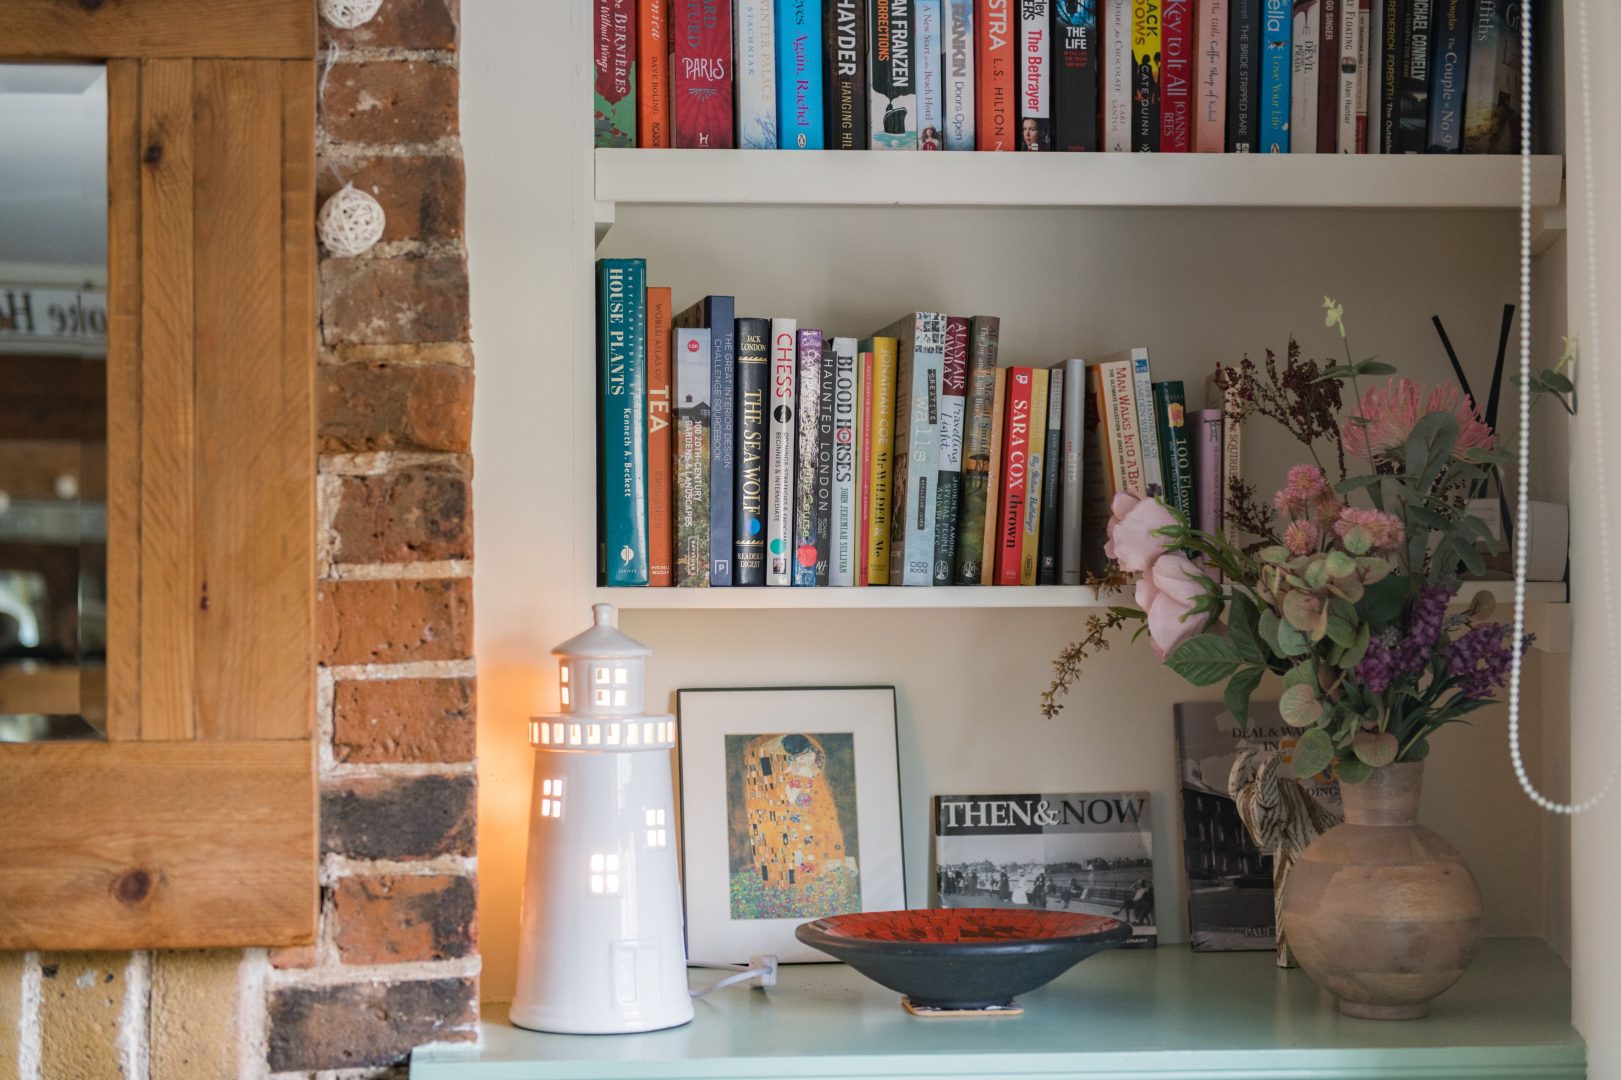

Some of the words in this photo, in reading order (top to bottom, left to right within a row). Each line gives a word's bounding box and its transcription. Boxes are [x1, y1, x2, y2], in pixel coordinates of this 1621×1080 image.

[600, 6, 612, 42] Without
[923, 14, 932, 33] New
[1146, 0, 1158, 38] ACK
[1162, 0, 1187, 33] Key
[1210, 2, 1220, 14] The
[951, 4, 967, 78] RANKIN
[1028, 30, 1043, 53] The
[1065, 26, 1086, 38] THE
[1210, 17, 1220, 37] Little
[1240, 23, 1250, 41] THE
[1324, 13, 1335, 41] SINGER
[1344, 11, 1356, 51] FLOATING
[596, 44, 610, 73] Wings
[891, 20, 909, 87] FRANZEN
[923, 35, 932, 54] Start
[1065, 38, 1087, 50] LIFE
[1167, 36, 1183, 57] to
[1206, 40, 1219, 64] Coffee
[1239, 43, 1250, 69] BRIDE
[1294, 44, 1303, 73] PRADA
[1303, 41, 1314, 74] DEVIL
[1410, 34, 1428, 81] CONNELLY
[1446, 37, 1456, 51] The
[651, 56, 660, 79] DAVE
[681, 57, 725, 81] PARIS
[993, 58, 1004, 81] L.S.
[1141, 65, 1150, 98] CATE
[1167, 60, 1187, 71] It
[1204, 66, 1218, 87] Shop
[1272, 55, 1282, 81] Love
[1385, 54, 1396, 100] FORSYTH
[1440, 51, 1458, 100] Couple
[650, 82, 660, 115] BOLING
[923, 71, 933, 95] Beach
[953, 81, 965, 111] Doors
[1025, 56, 1043, 113] Betrayer
[1167, 73, 1188, 96] All
[1239, 71, 1250, 111] STRIPPED
[1271, 84, 1282, 107] Your
[1344, 80, 1354, 98] Alan
[795, 79, 810, 126] Rachel
[841, 81, 853, 129] HANGING
[924, 97, 935, 121] Hotel
[993, 87, 1005, 137] HILTON
[1111, 100, 1119, 132] SANTOS
[1141, 99, 1150, 136] QUINN
[1343, 99, 1353, 125] Hunter
[1385, 102, 1393, 118] The
[952, 114, 965, 141] Open
[1163, 112, 1175, 136] REES
[1174, 100, 1186, 147] JOANNA
[1238, 113, 1249, 136] BARE
[1440, 109, 1455, 144] No.9
[609, 268, 625, 324] HOUSE
[654, 303, 664, 337] WORLD
[980, 326, 989, 342] The
[654, 340, 663, 367] ATLAS
[724, 333, 733, 351] THE
[740, 343, 767, 352] LONDON
[746, 335, 761, 343] JACK
[943, 324, 955, 387] SAWDAY
[977, 342, 988, 355] Joy
[609, 330, 625, 396] PLANTS
[713, 338, 722, 394] CHALLENGE
[724, 353, 733, 384] GREAT
[776, 332, 793, 399] CHESS
[952, 322, 967, 390] ALASTAIR
[836, 355, 853, 414] BLOOD
[879, 349, 891, 415] JONATHAN
[975, 374, 986, 395] Light
[1108, 368, 1116, 378] THE
[1115, 367, 1128, 393] MAN
[743, 388, 762, 425] THE
[821, 358, 834, 434] HAUNTED
[928, 373, 937, 421] CREATIVE
[974, 398, 983, 412] Bus
[1110, 378, 1118, 403] ULTIMATE
[649, 384, 670, 434] TEA
[723, 386, 733, 432] INTERIOR
[1011, 399, 1029, 448] SARA
[1112, 403, 1121, 432] COLLECTION
[1119, 394, 1132, 431] WALKS
[1146, 400, 1157, 445] HANDBOOK
[623, 408, 633, 446] Kenneth
[684, 420, 693, 461] GARDENS
[693, 420, 702, 434] 100
[713, 398, 722, 462] SOURCEBOOK
[878, 418, 889, 445] COE
[940, 412, 953, 450] Light
[947, 402, 963, 465] Travelling
[970, 415, 982, 452] Company
[981, 421, 991, 455] Smith
[623, 450, 633, 460] A.
[723, 433, 732, 468] DESIGN
[742, 429, 762, 463] SEA
[774, 431, 782, 468] BEGINNERS
[836, 417, 852, 483] HORSES
[1030, 455, 1040, 468] My
[1123, 434, 1137, 457] INTO
[1175, 438, 1190, 469] 100
[623, 462, 633, 498] Beckett
[693, 436, 703, 502] 20TH-CENTURY
[818, 442, 831, 511] LONDON
[1009, 450, 1025, 489] COX
[1030, 469, 1039, 495] Italian
[684, 471, 693, 528] LANDSCAPES
[742, 466, 761, 516] WOLF
[773, 475, 781, 522] INTERMEDIATE
[840, 487, 849, 504] JOHN
[874, 470, 887, 525] WILDER
[942, 482, 952, 520] SPECIAL
[950, 476, 959, 522] JOURNEYS
[802, 494, 815, 538] Course
[839, 505, 849, 540] JEREMIAH
[1006, 493, 1023, 549] thrown
[1025, 495, 1038, 534] Bulldozer
[874, 527, 883, 537] &
[941, 522, 950, 554] PEOPLE
[947, 526, 957, 557] AMONG
[839, 541, 849, 574] SULLIVAN
[1264, 741, 1280, 751] IN
